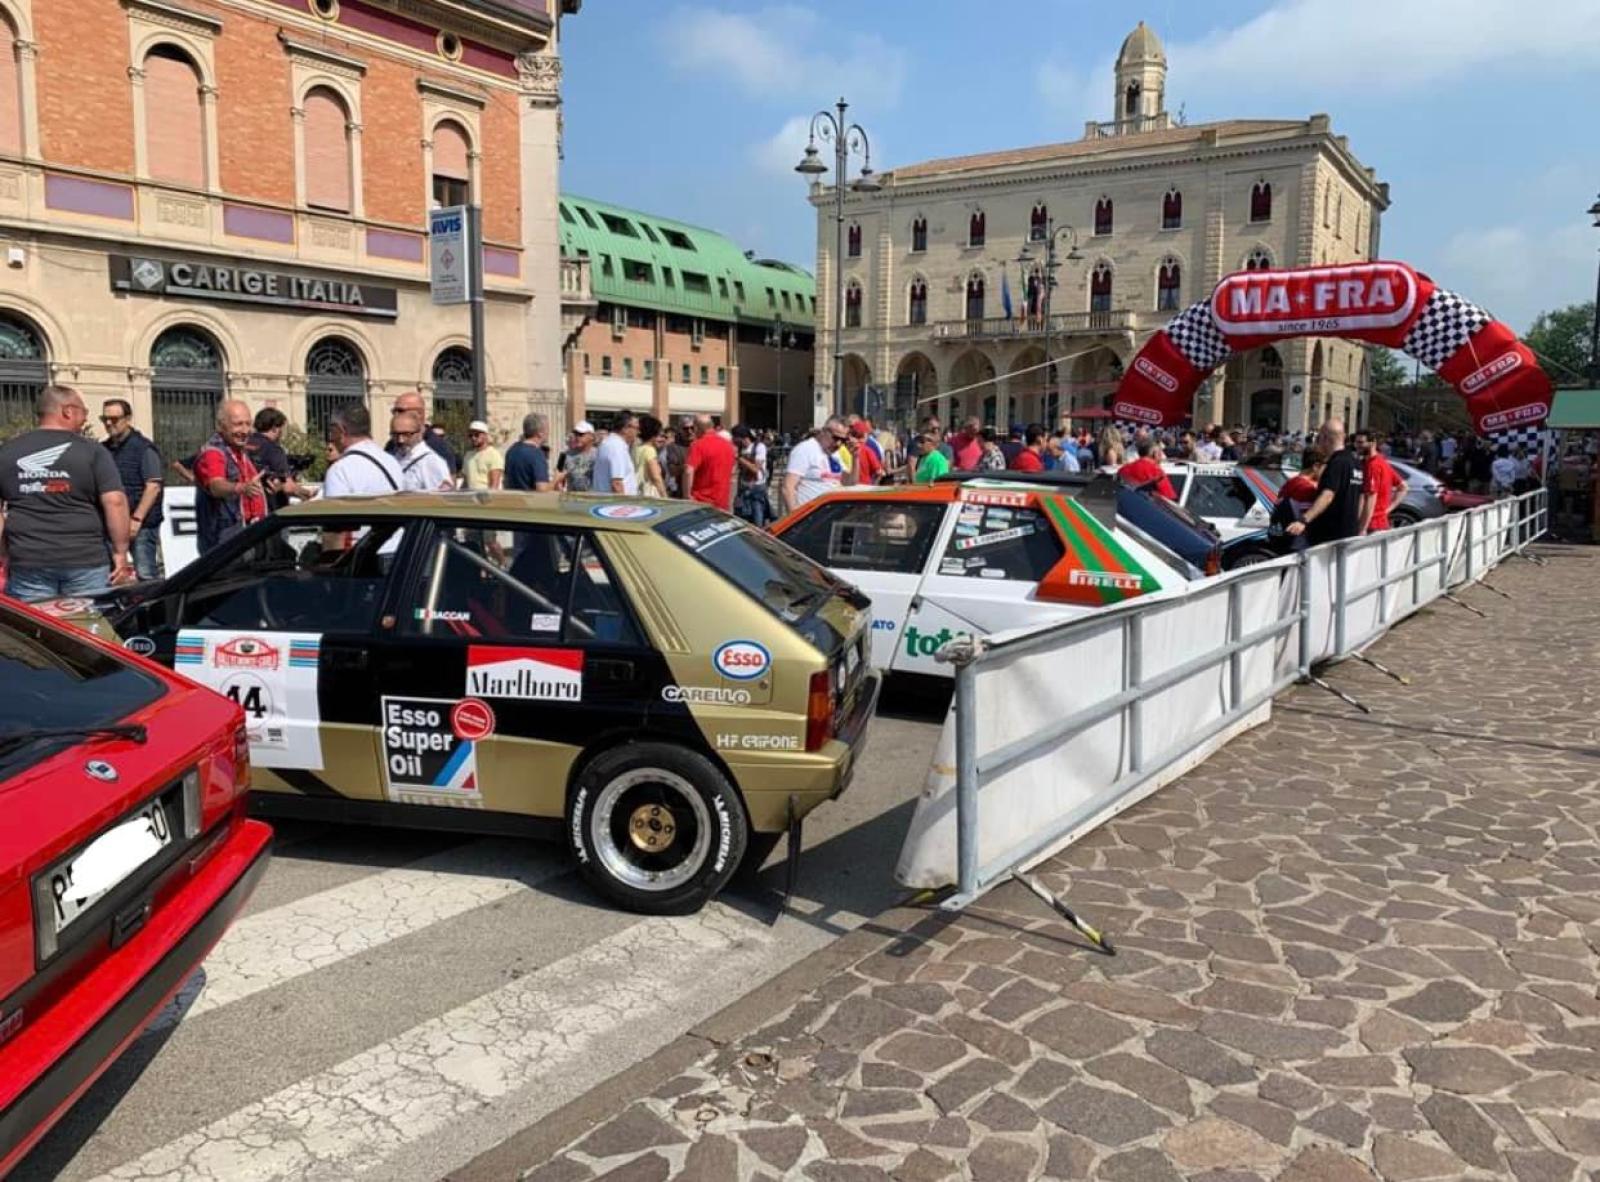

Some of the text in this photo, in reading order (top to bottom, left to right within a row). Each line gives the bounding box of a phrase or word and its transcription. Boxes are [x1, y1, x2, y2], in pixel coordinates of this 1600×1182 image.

[171, 263, 363, 305] CARIGE ITALIA
[1278, 320, 1340, 332] since 1965
[17, 469, 71, 479] HONDA
[960, 489, 1026, 506] PIRELLI
[1069, 569, 1143, 590] PIRELLI
[472, 669, 579, 698] Marlboro
[663, 687, 749, 704] CARELLO
[388, 704, 441, 727] Esso
[388, 726, 453, 755] Super
[717, 734, 739, 748] HF
[390, 754, 422, 776] Oil
